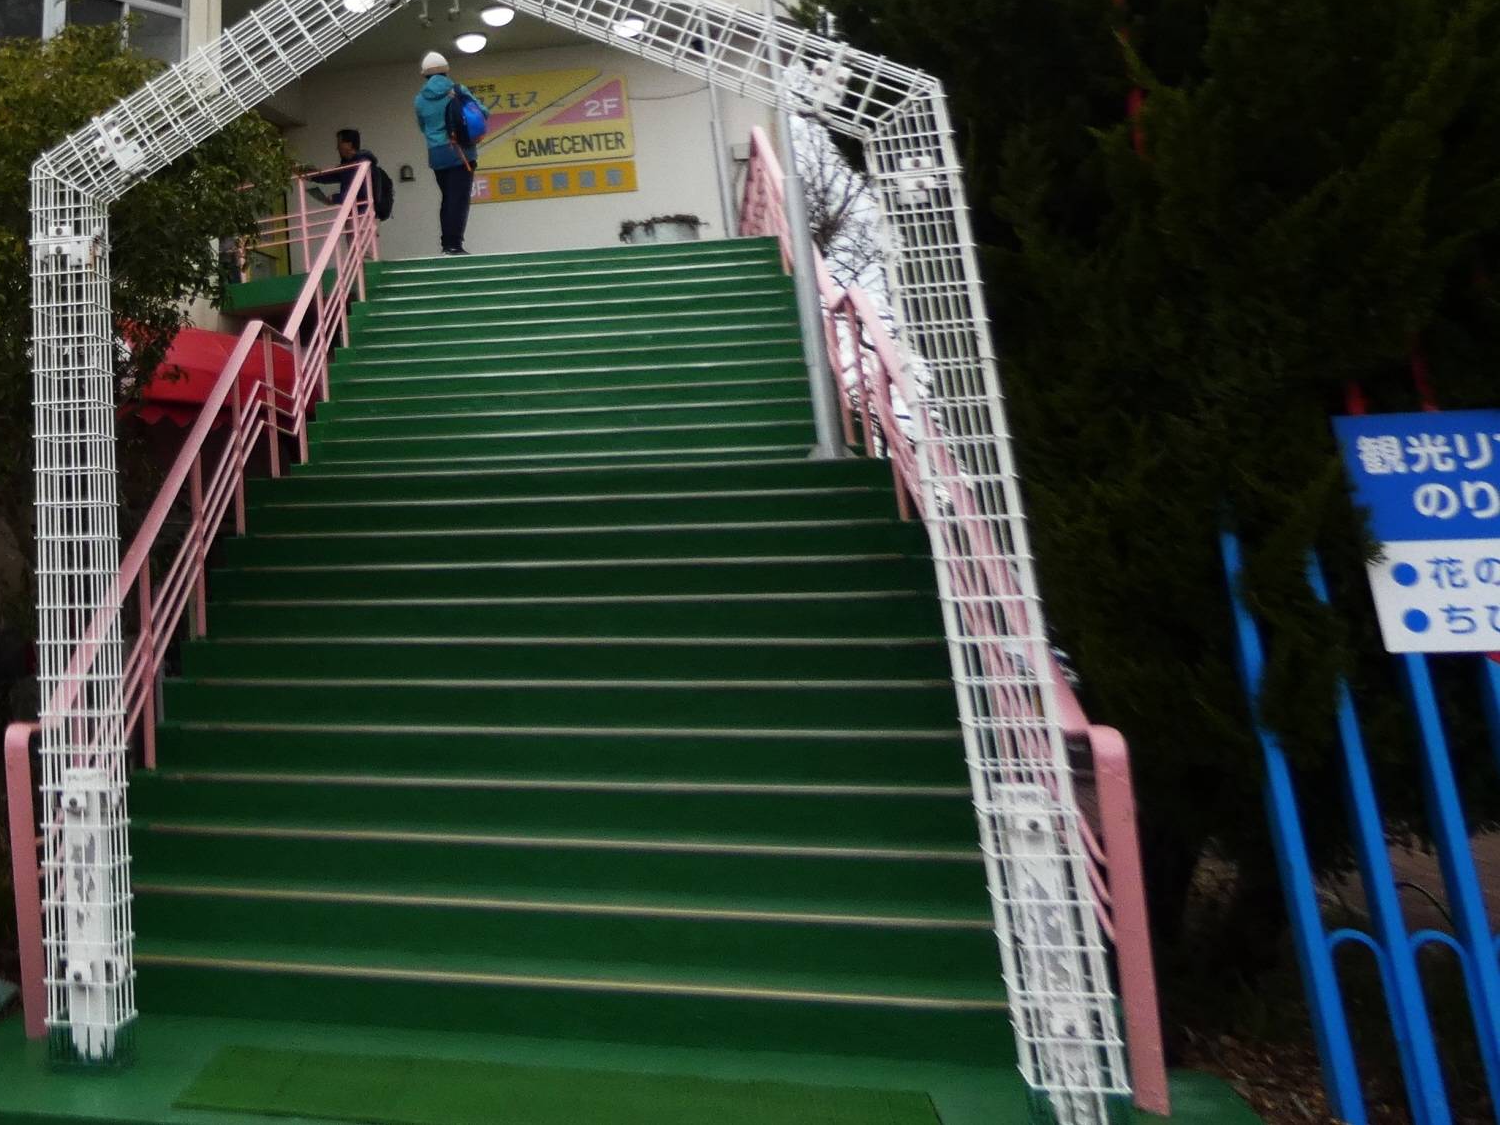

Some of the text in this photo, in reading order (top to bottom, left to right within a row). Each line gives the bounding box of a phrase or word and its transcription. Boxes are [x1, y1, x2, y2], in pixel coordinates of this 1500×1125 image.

[479, 91, 538, 111] スモス
[584, 97, 619, 118] 2F
[515, 132, 626, 159] GAMECENTER
[1356, 432, 1500, 474] 観光リ
